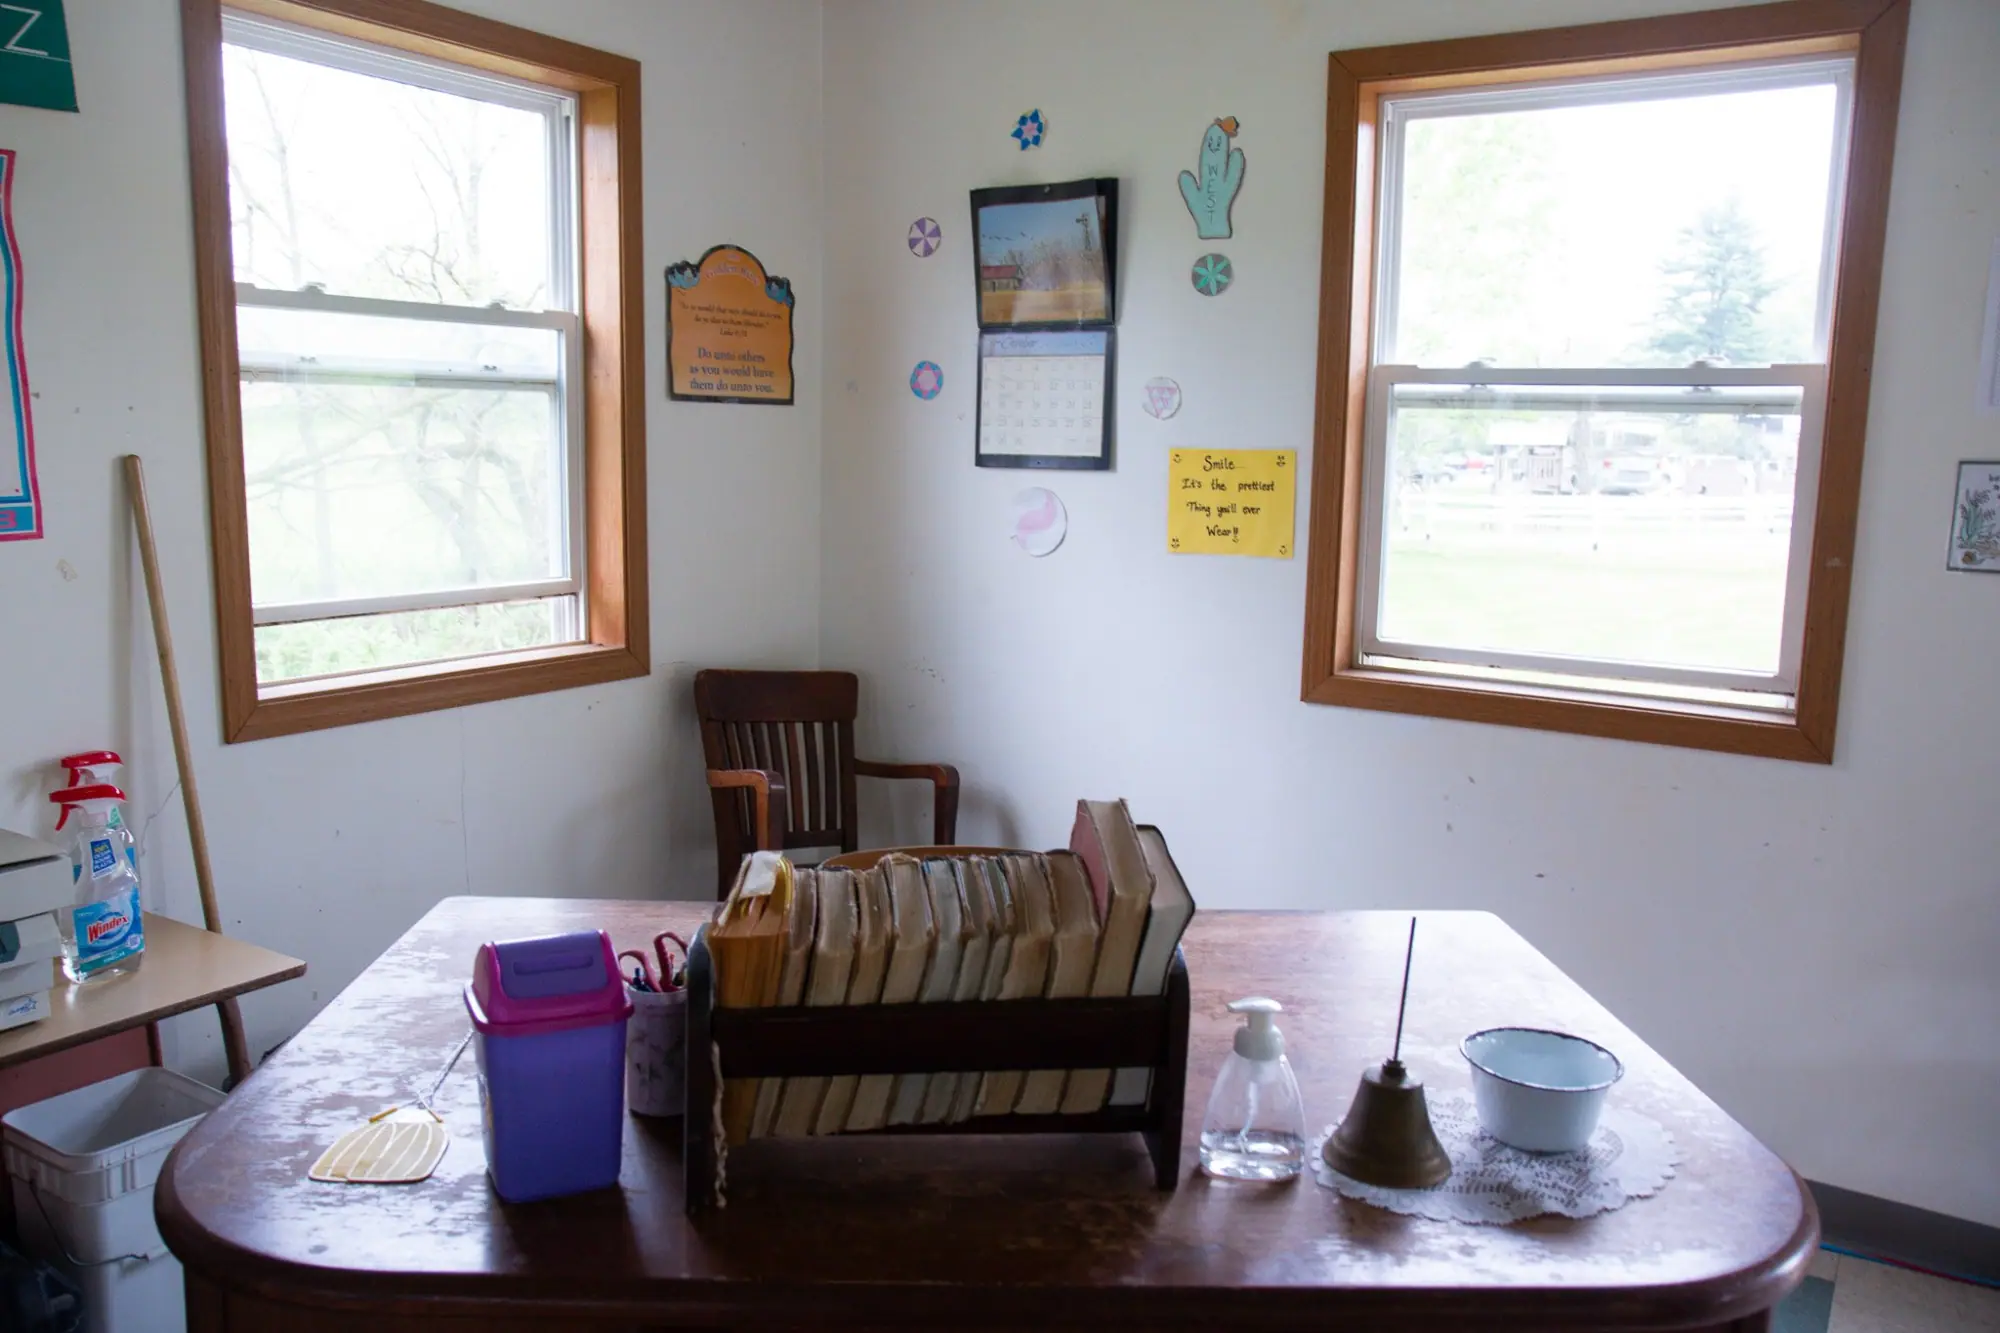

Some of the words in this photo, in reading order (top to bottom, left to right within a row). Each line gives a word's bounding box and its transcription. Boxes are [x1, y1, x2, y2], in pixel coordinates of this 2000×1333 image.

[0, 4, 49, 56] Z
[1207, 164, 1219, 225] WEST
[698, 347, 712, 359] Do
[738, 350, 766, 363] others
[701, 366, 720, 376] you
[723, 365, 751, 377] would
[752, 366, 775, 378] have
[689, 377, 714, 390] them
[716, 379, 729, 391] do
[730, 383, 753, 392] unto
[1203, 455, 1236, 471] Smile
[1182, 478, 1202, 489] It's
[1211, 478, 1227, 491] the
[1186, 501, 1211, 518] Thing
[1217, 504, 1237, 518] you'll
[1243, 506, 1261, 515] ever
[87, 915, 129, 944] Windex
